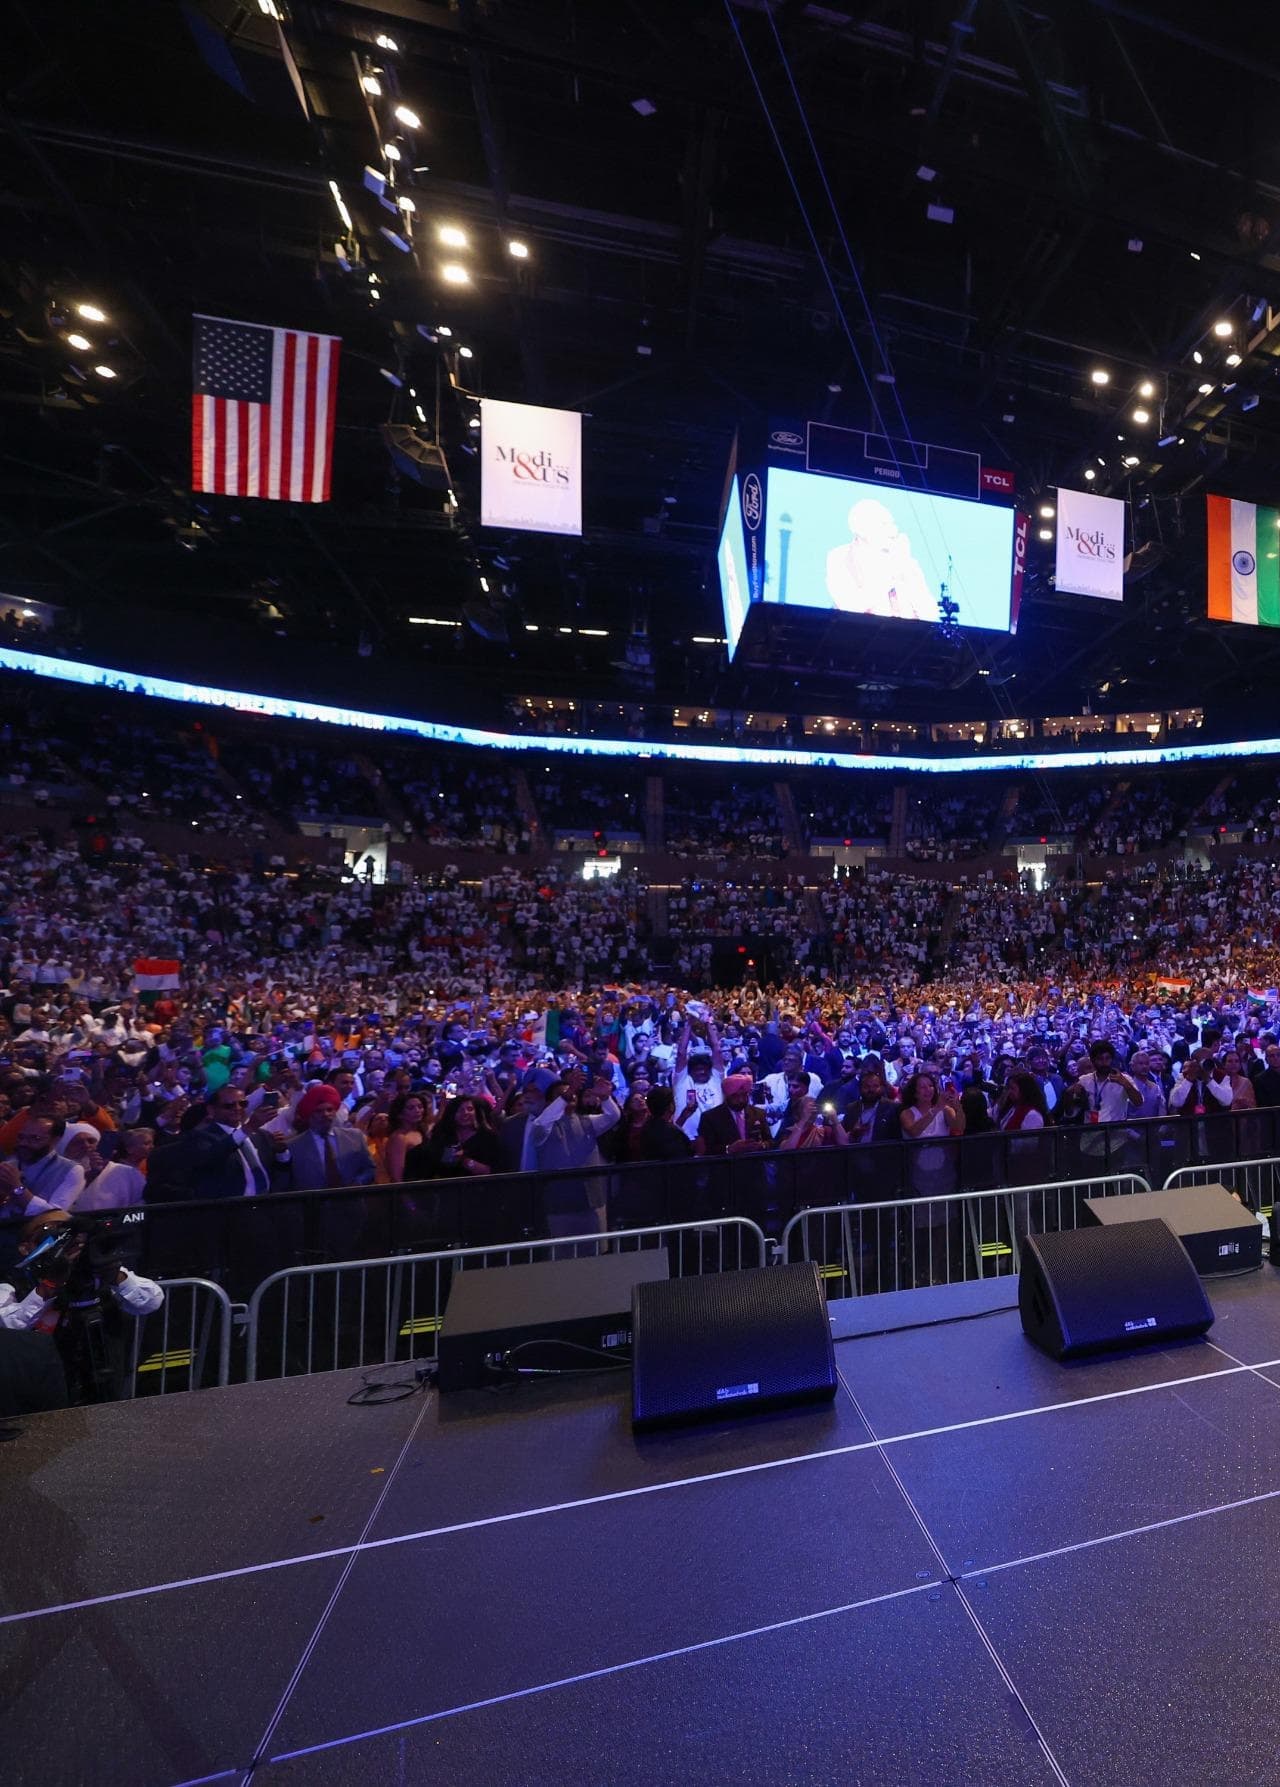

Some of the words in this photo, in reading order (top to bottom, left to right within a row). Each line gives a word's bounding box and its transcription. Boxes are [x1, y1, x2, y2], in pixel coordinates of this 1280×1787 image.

[495, 445, 552, 467] Modi
[874, 466, 900, 478] PERIOD
[984, 474, 1010, 487] TCL
[745, 483, 760, 520] Ford
[1064, 526, 1104, 545] Modi
[1014, 522, 1027, 576] TCL
[122, 1212, 145, 1224] ANI
